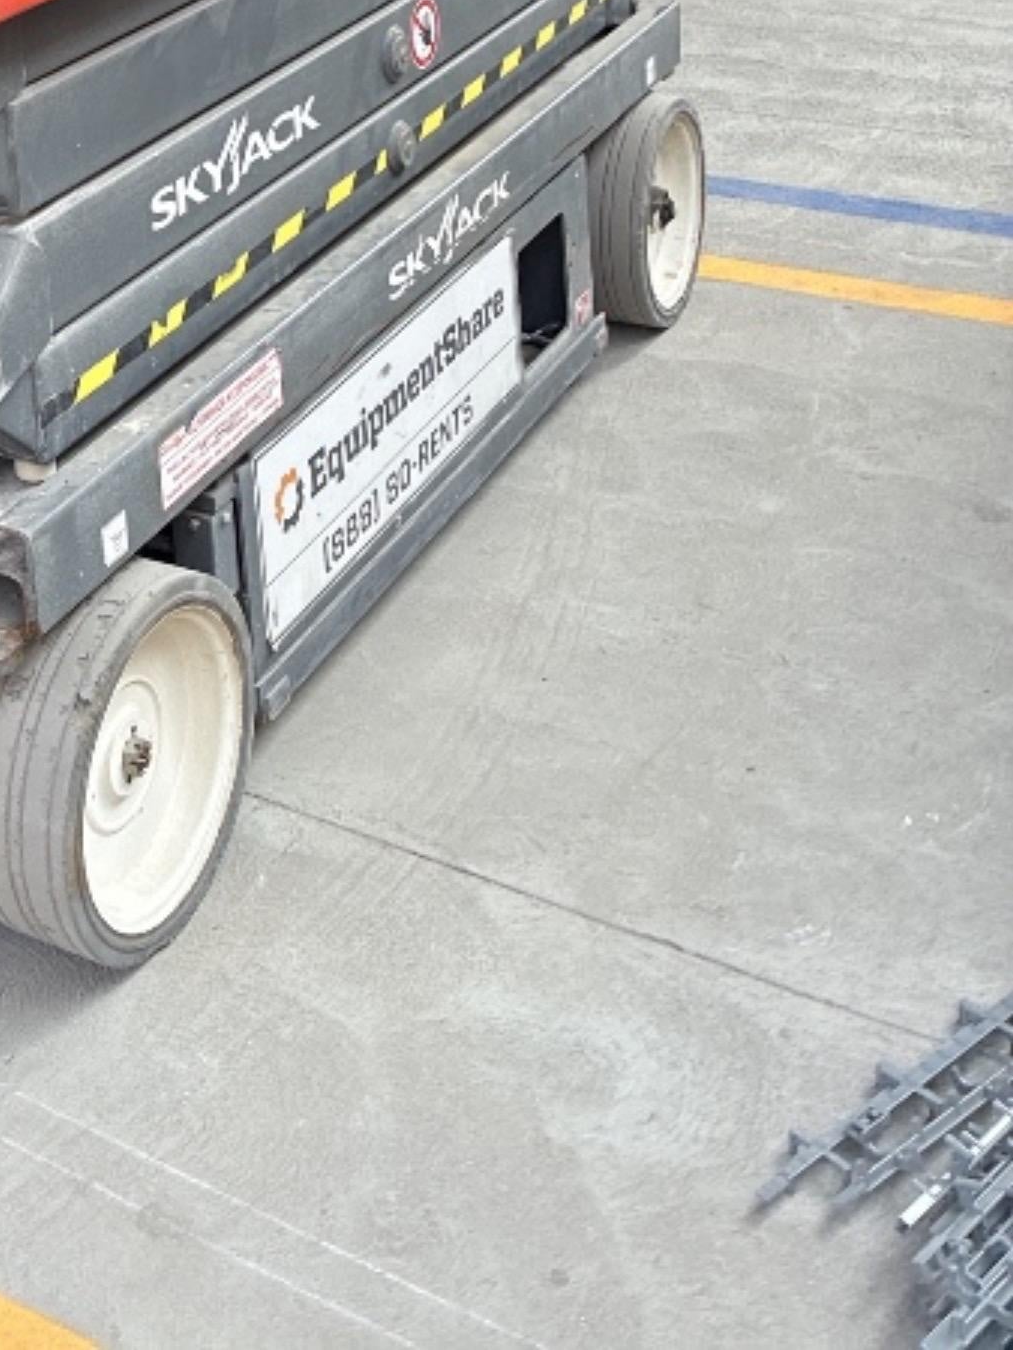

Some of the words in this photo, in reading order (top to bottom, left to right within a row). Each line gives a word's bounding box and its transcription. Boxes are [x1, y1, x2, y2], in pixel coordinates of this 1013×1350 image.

[150, 94, 322, 232] SKYJACK
[388, 170, 511, 301] SKYJACK
[307, 288, 505, 498] EquipmentShare
